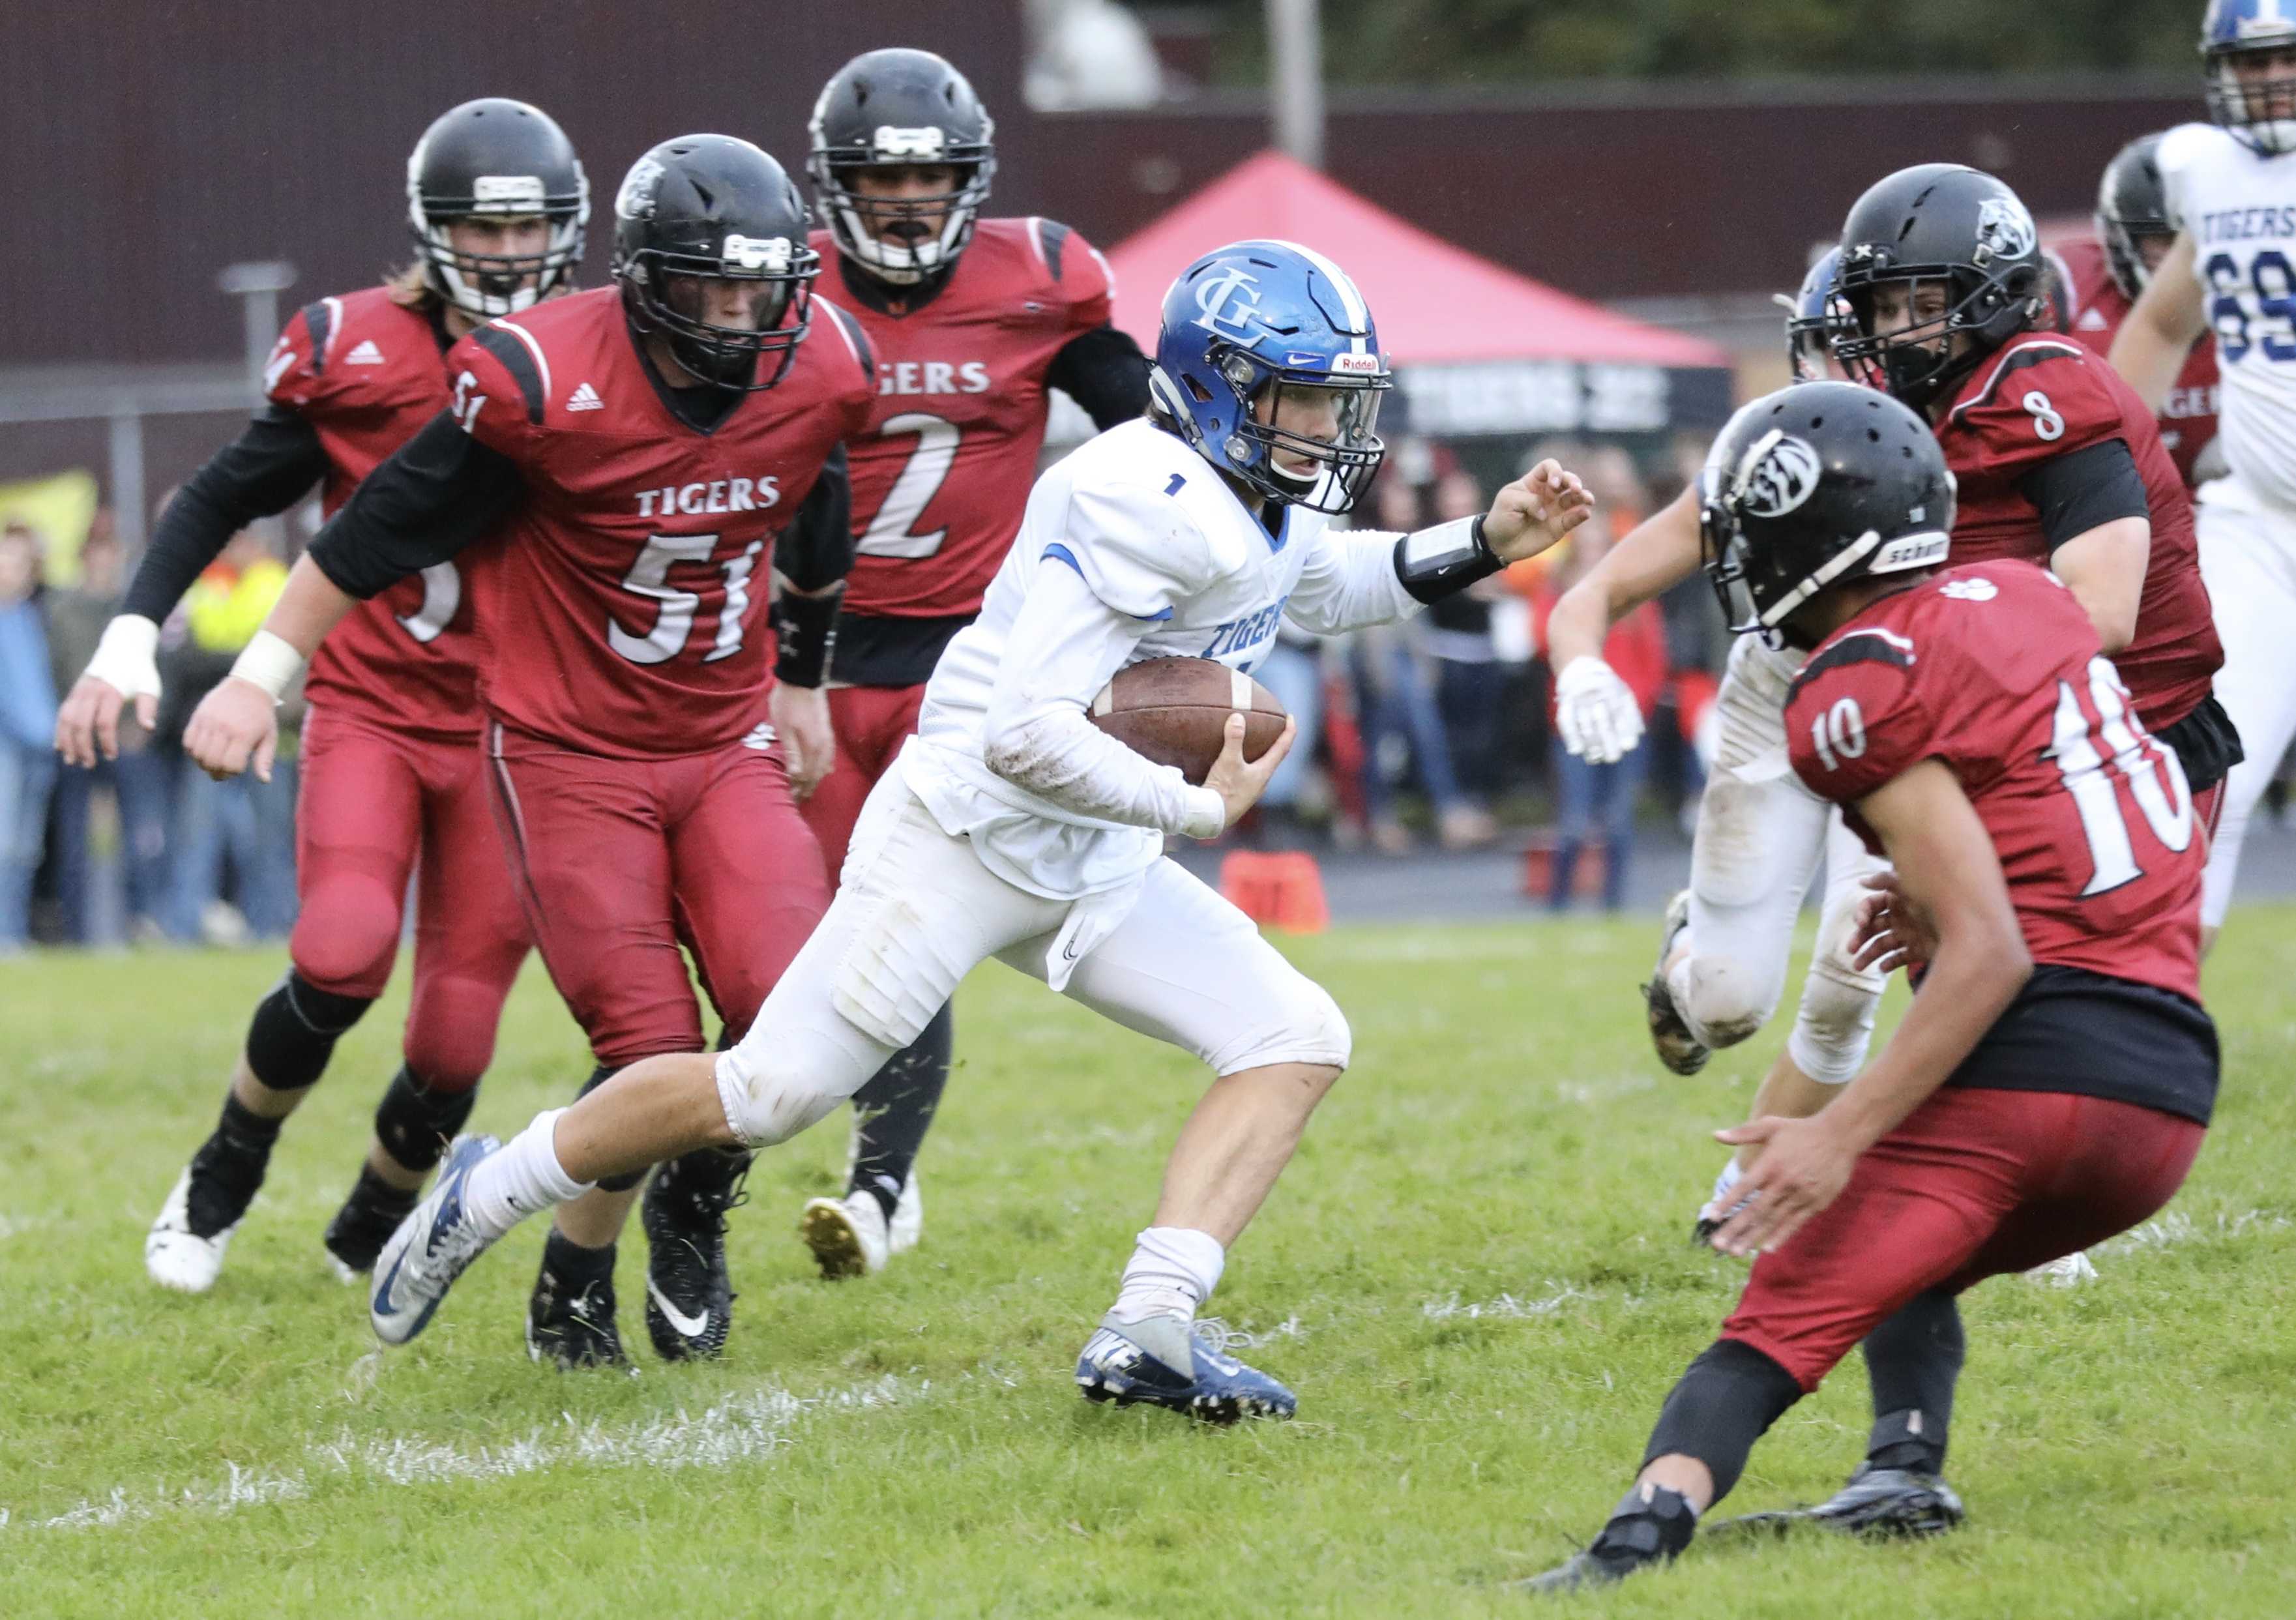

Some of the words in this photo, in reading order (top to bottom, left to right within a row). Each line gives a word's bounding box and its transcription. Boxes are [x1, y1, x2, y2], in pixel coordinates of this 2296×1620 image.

[2205, 250, 2296, 362] 69
[2023, 390, 2065, 441] 8
[634, 481, 781, 518] TIGERS
[857, 413, 960, 558] 2
[1164, 473, 1186, 497] 1
[608, 534, 763, 664] 51
[1811, 698, 1866, 772] 10
[2038, 656, 2193, 899] 10
